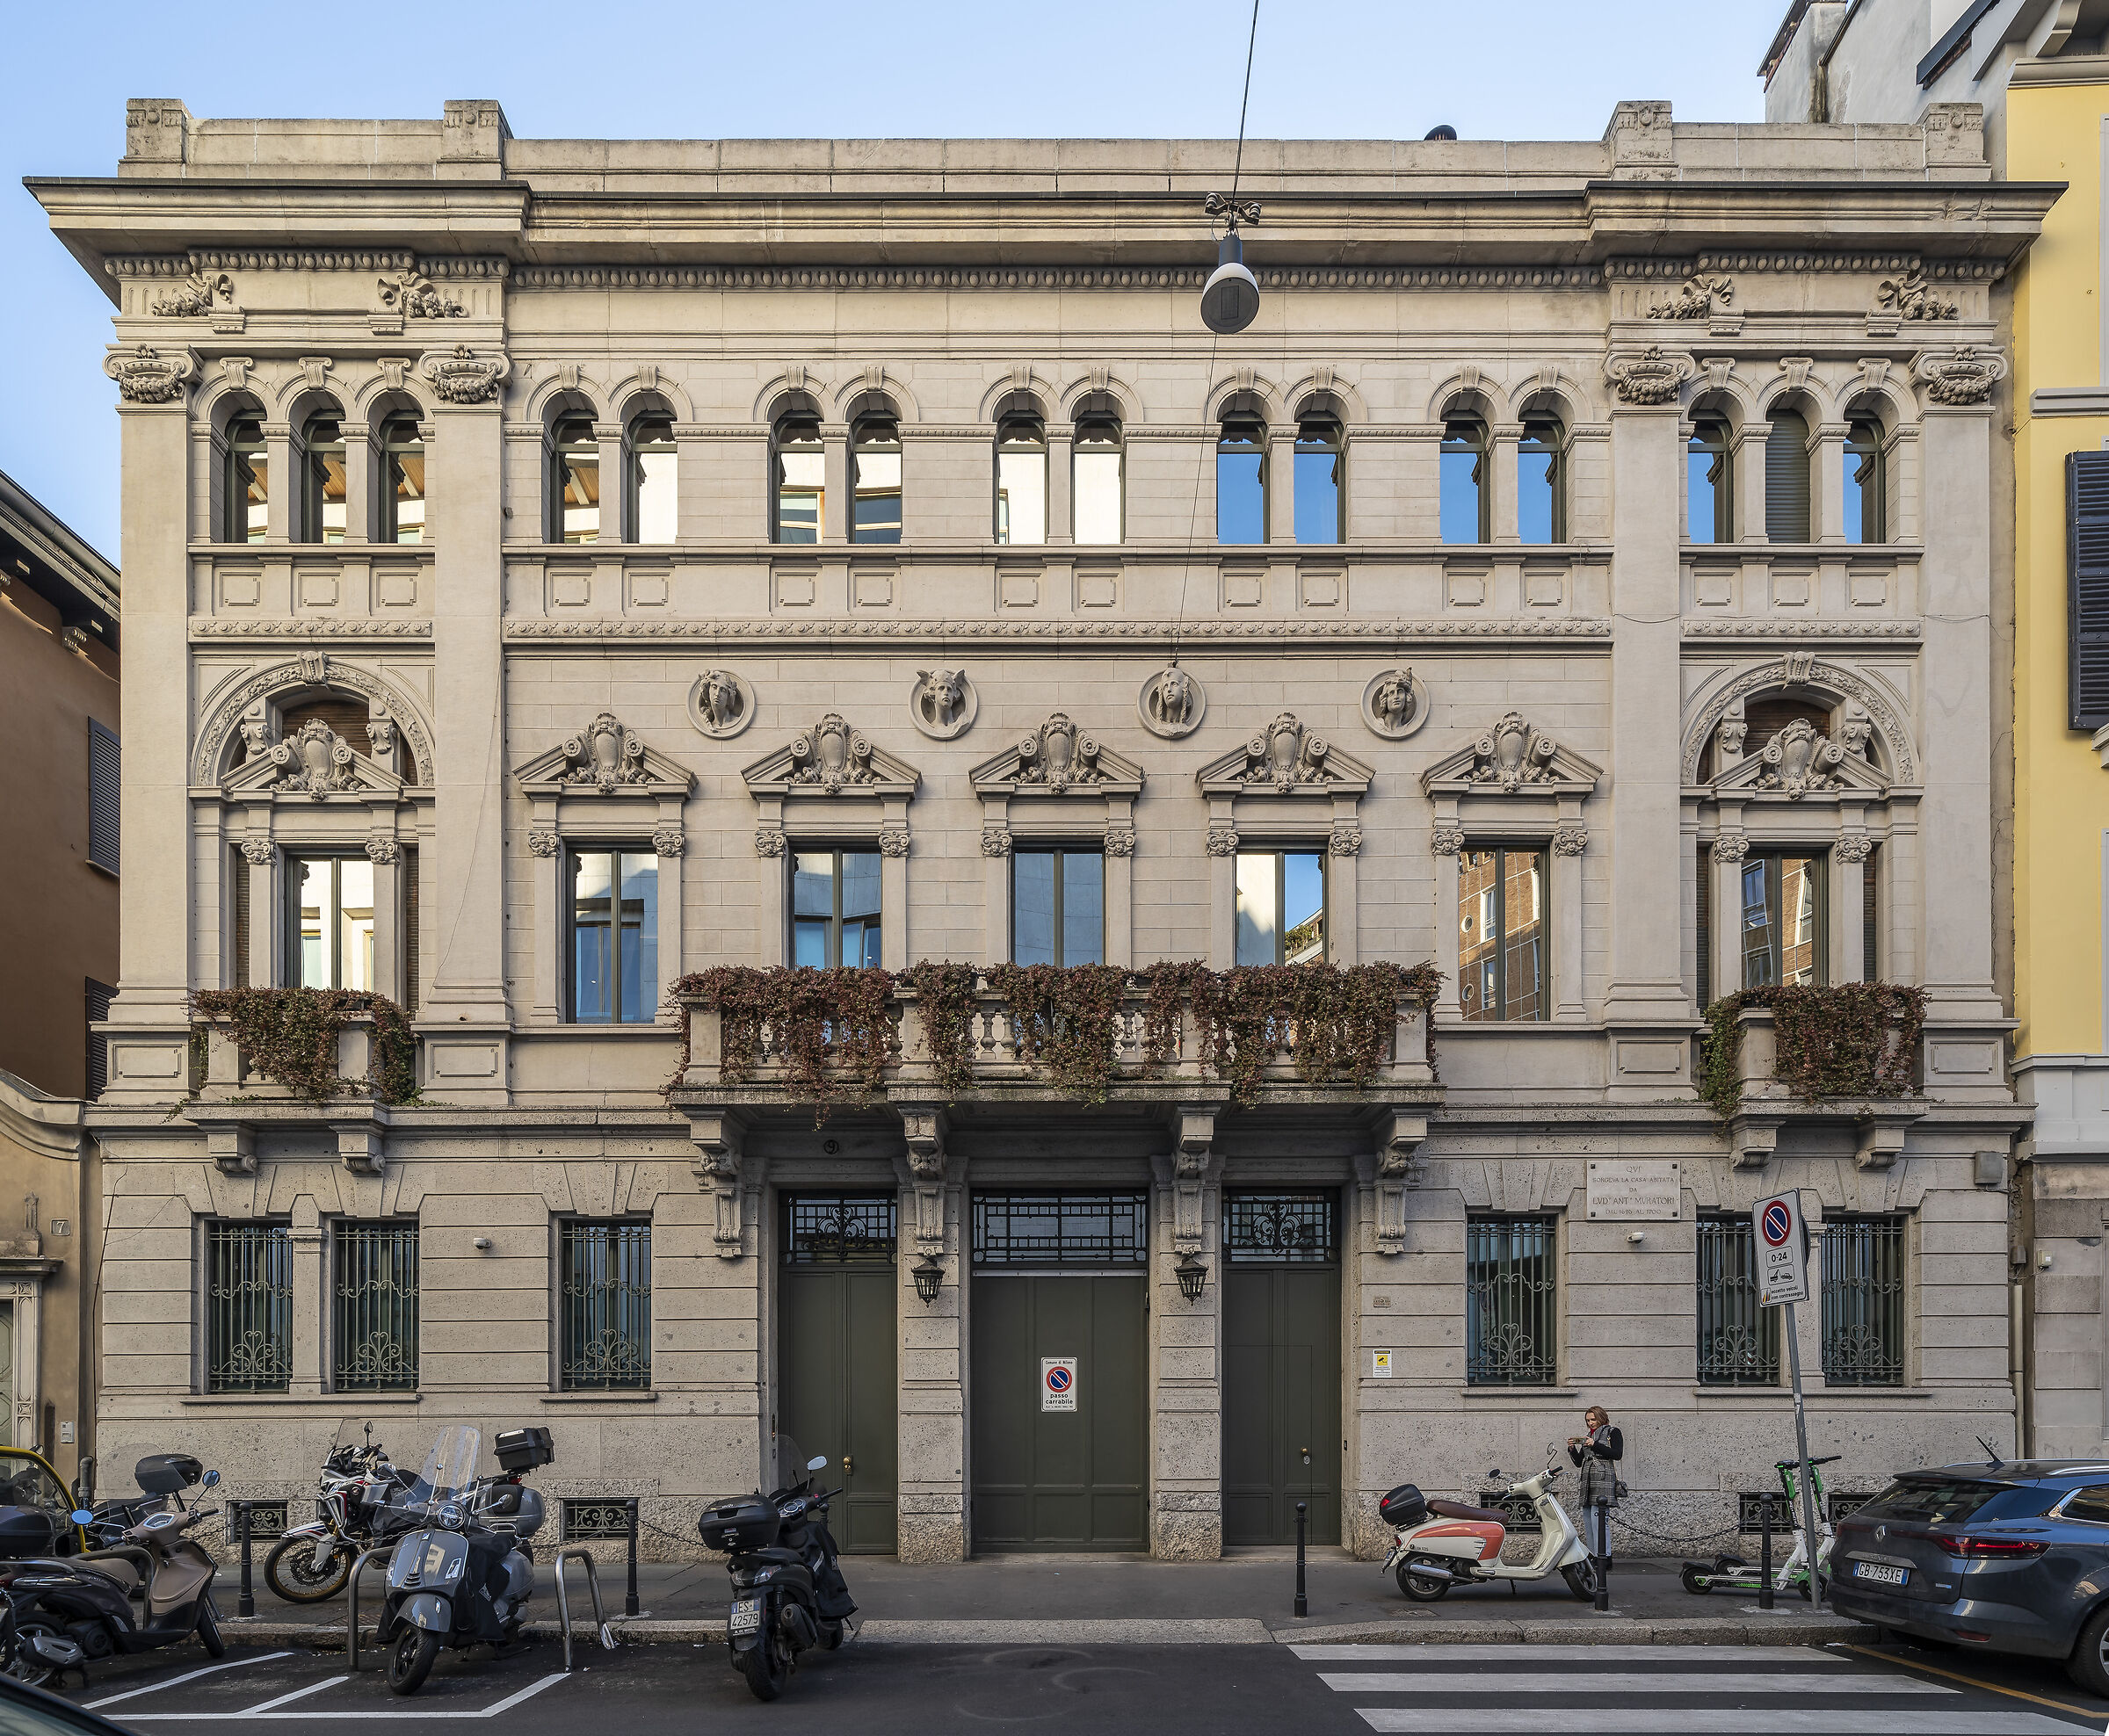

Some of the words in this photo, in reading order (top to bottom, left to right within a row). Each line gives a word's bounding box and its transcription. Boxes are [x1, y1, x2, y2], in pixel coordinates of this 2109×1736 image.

[56, 1221, 66, 1233] 7
[1772, 1251, 1787, 1262] 0-24
[738, 1602, 749, 1613] ES
[732, 1613, 758, 1627] 42579
